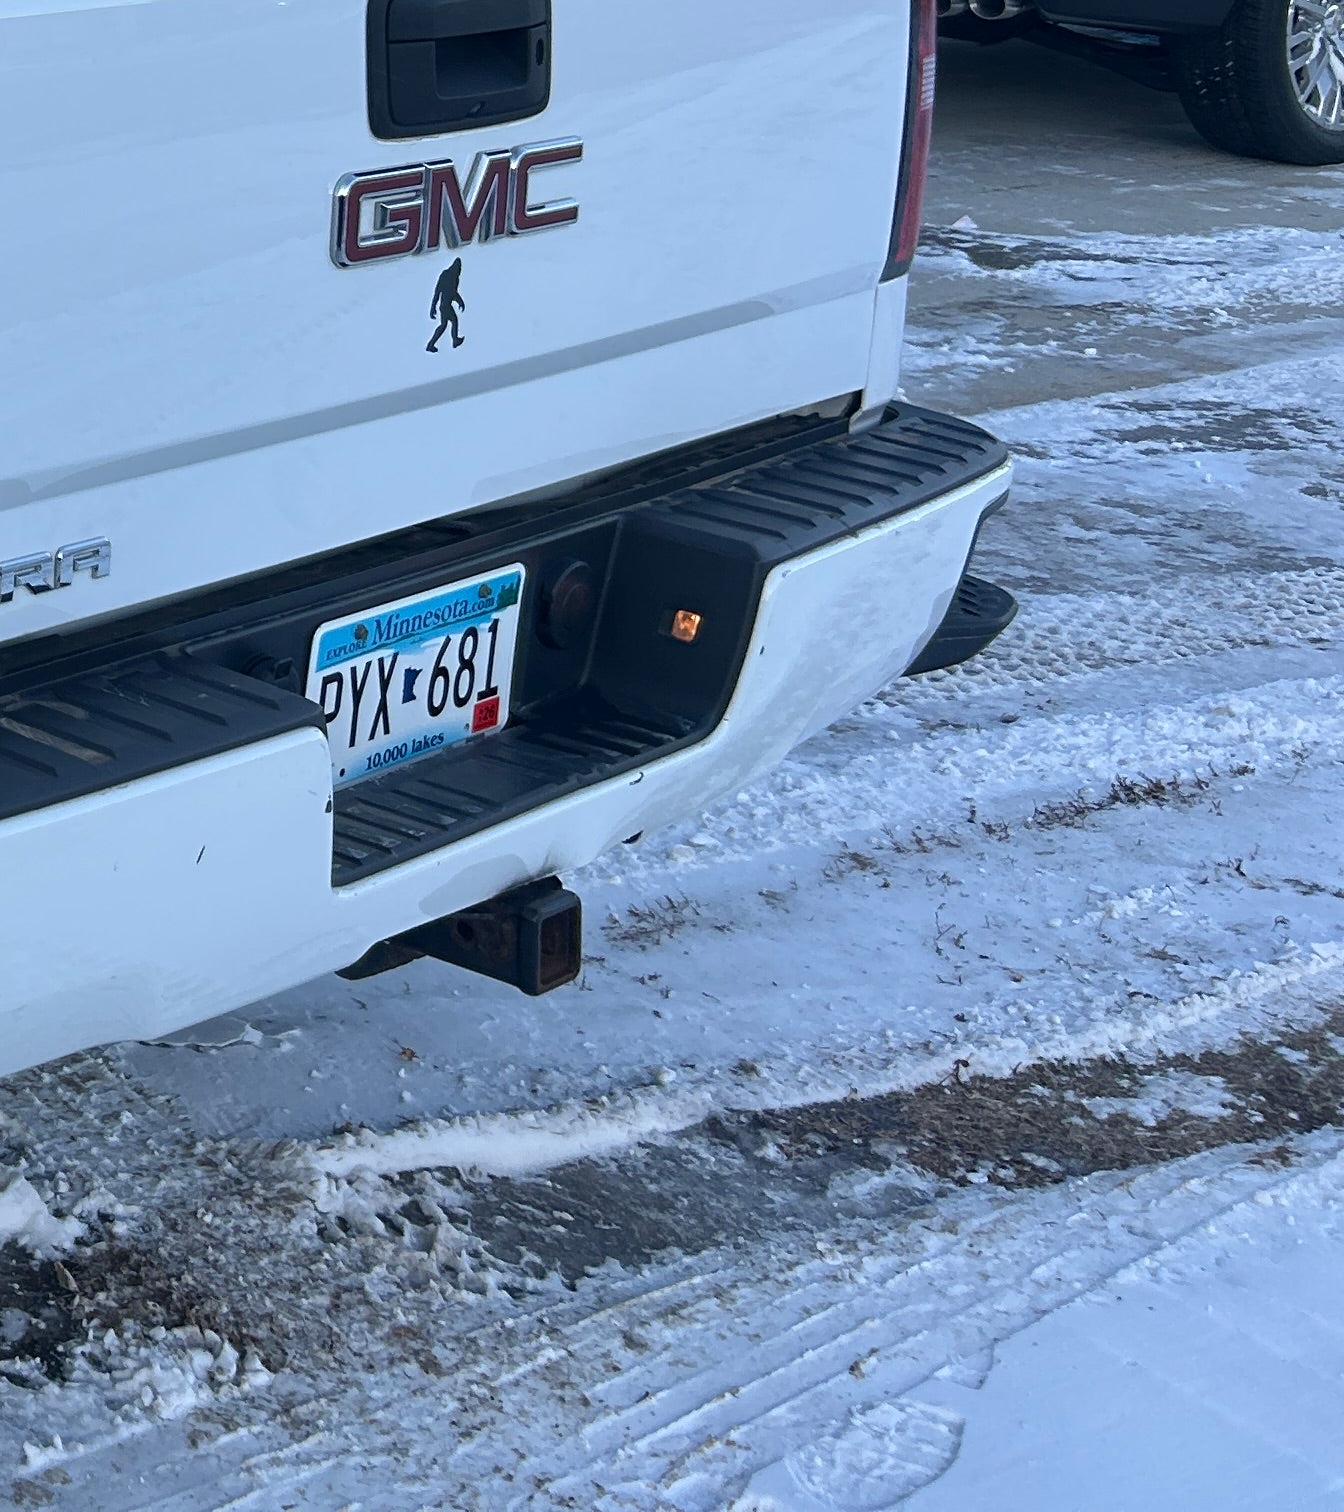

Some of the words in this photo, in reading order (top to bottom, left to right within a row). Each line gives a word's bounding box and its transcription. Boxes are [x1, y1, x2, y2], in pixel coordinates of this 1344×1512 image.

[329, 135, 584, 269] GMC
[325, 639, 369, 662] EXPLORE
[372, 595, 495, 646] Minnesota.com
[319, 651, 400, 748] PYX
[427, 617, 500, 717] 681
[365, 742, 409, 772] 10,000
[411, 732, 445, 755] lakes
